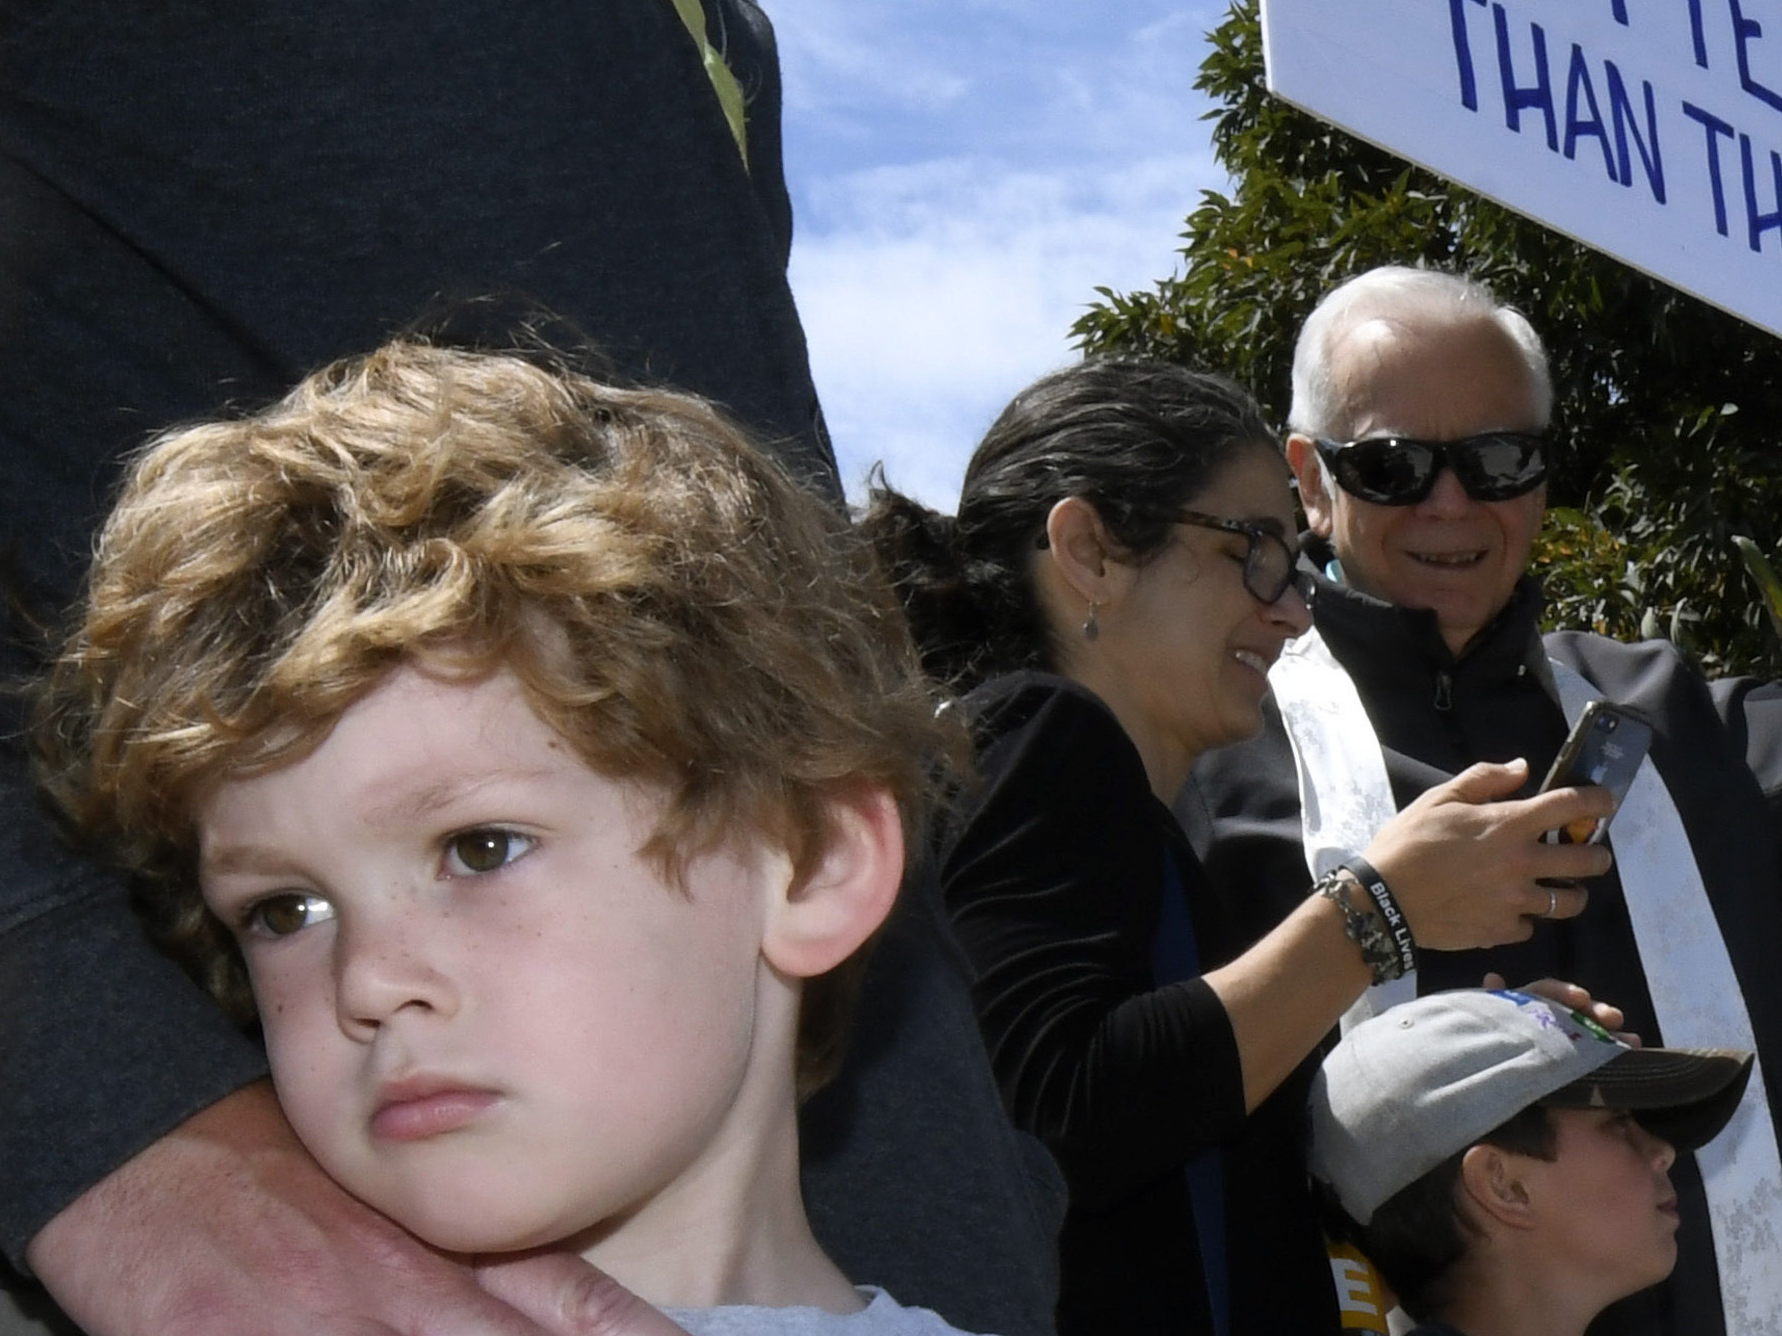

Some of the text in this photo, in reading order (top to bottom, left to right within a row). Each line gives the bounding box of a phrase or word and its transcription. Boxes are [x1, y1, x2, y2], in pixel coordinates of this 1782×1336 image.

[1446, 0, 1666, 204] THAN
[1370, 882, 1414, 970] Black Lives
